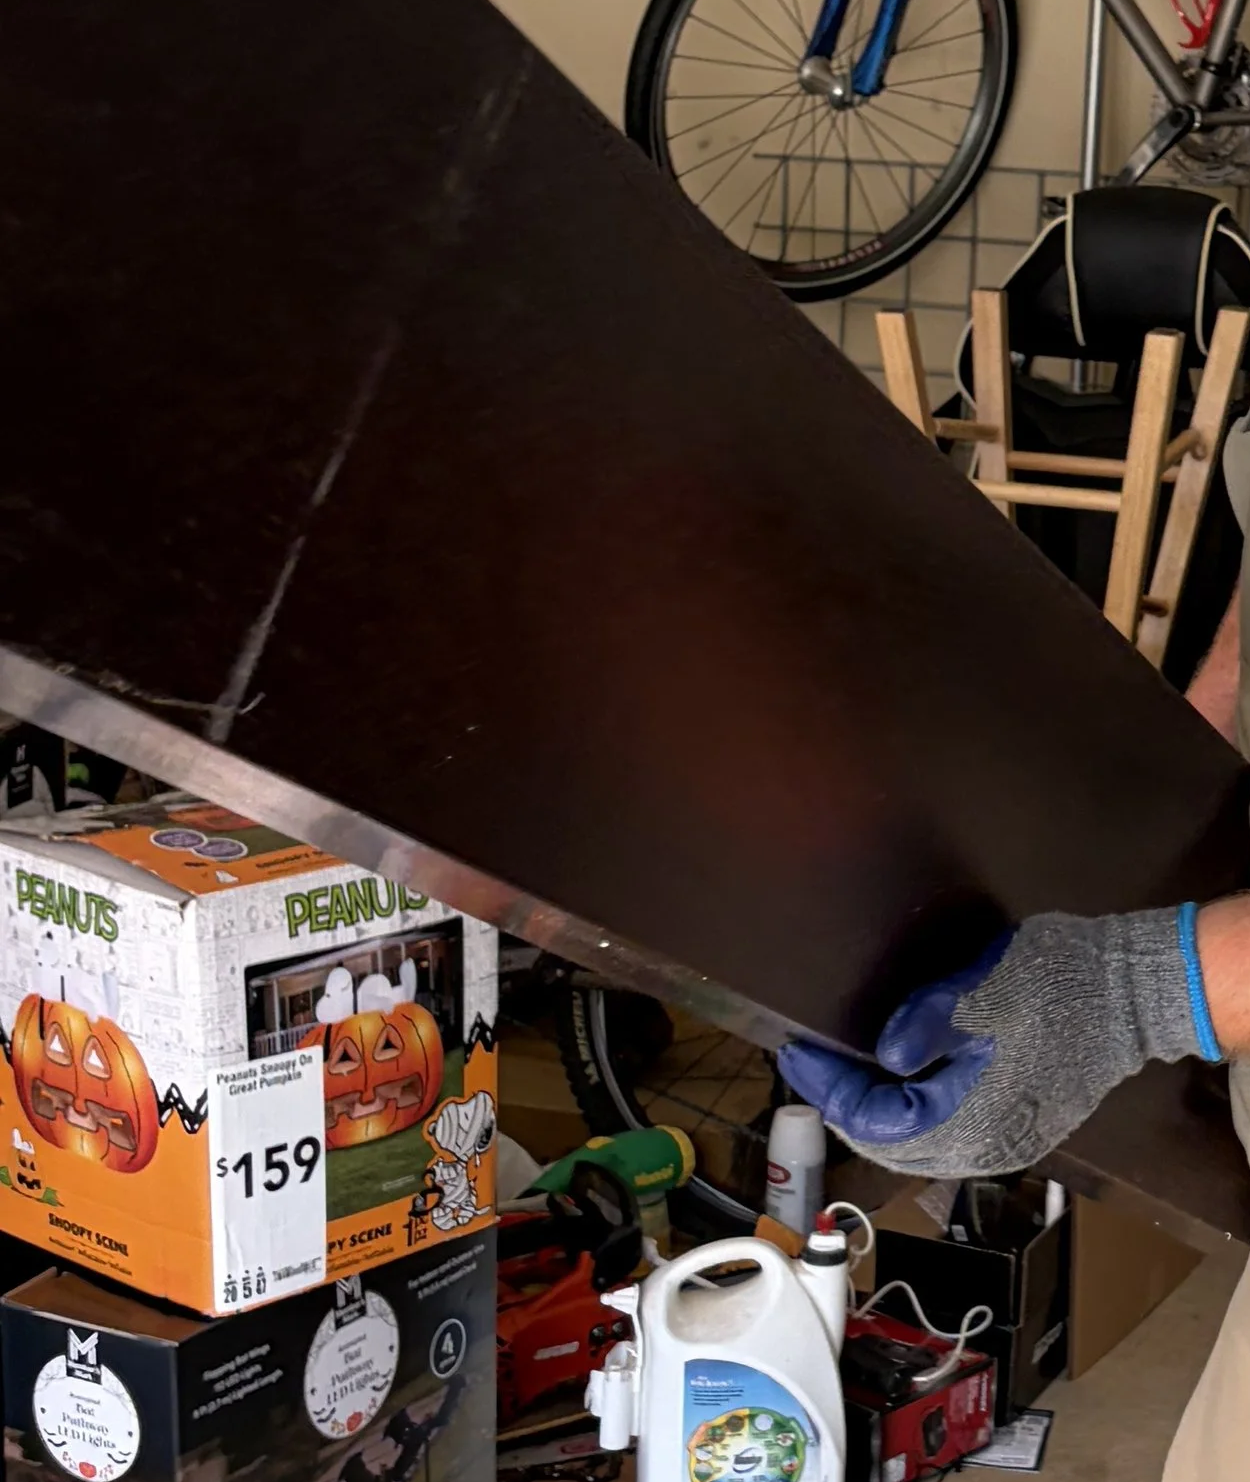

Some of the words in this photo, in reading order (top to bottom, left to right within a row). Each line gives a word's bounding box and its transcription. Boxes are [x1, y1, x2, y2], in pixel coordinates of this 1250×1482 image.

[16, 869, 120, 944] PEANUTS
[216, 1067, 257, 1085] Peanuts
[299, 1053, 313, 1066] On
[229, 1081, 257, 1096] Great
[349, 1222, 393, 1247] SCENE
